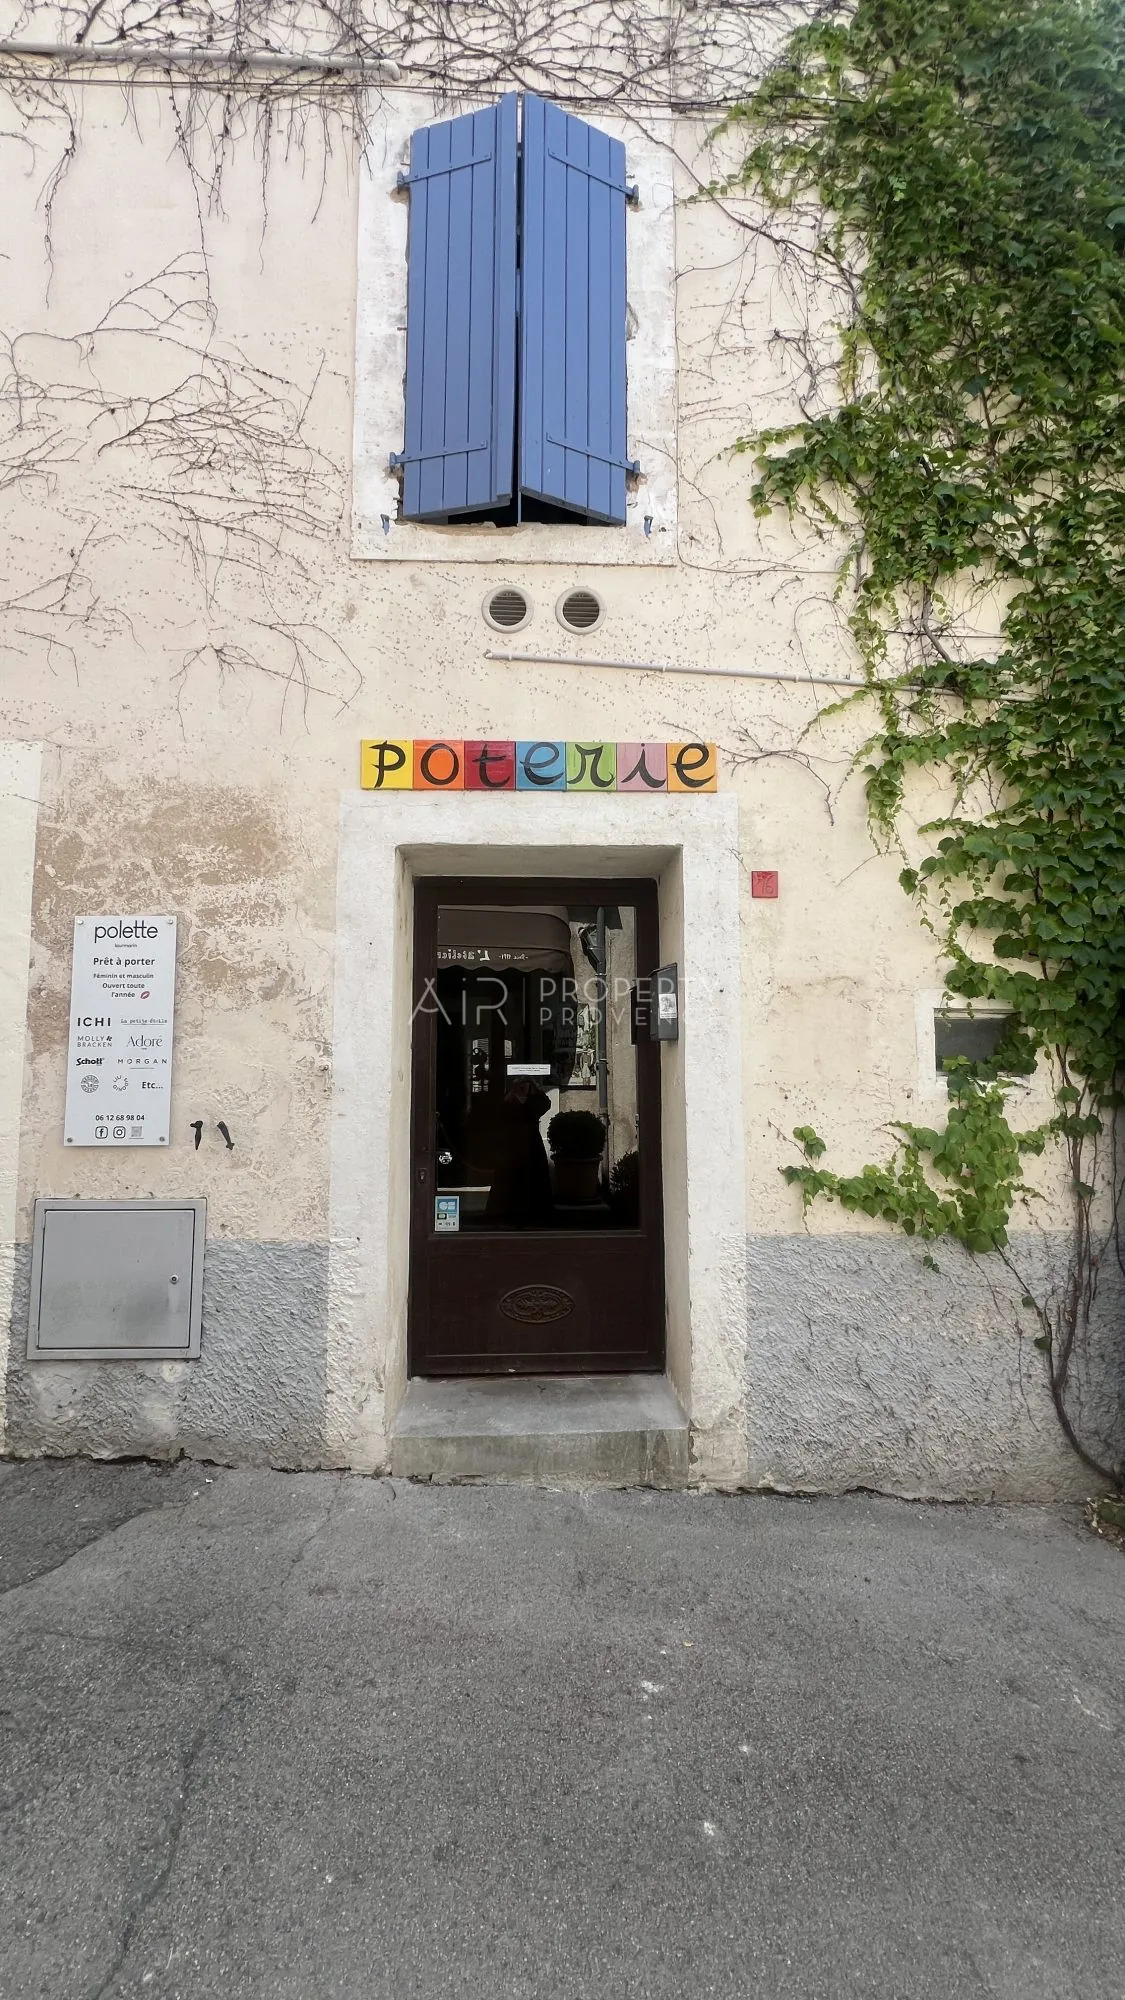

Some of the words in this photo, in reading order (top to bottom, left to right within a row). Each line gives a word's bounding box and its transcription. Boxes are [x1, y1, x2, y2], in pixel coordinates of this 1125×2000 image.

[94, 920, 158, 943] polette
[93, 957, 113, 966] Prêt
[116, 957, 122, 966] à
[124, 958, 155, 967] porter
[77, 1017, 111, 1027] ICHI
